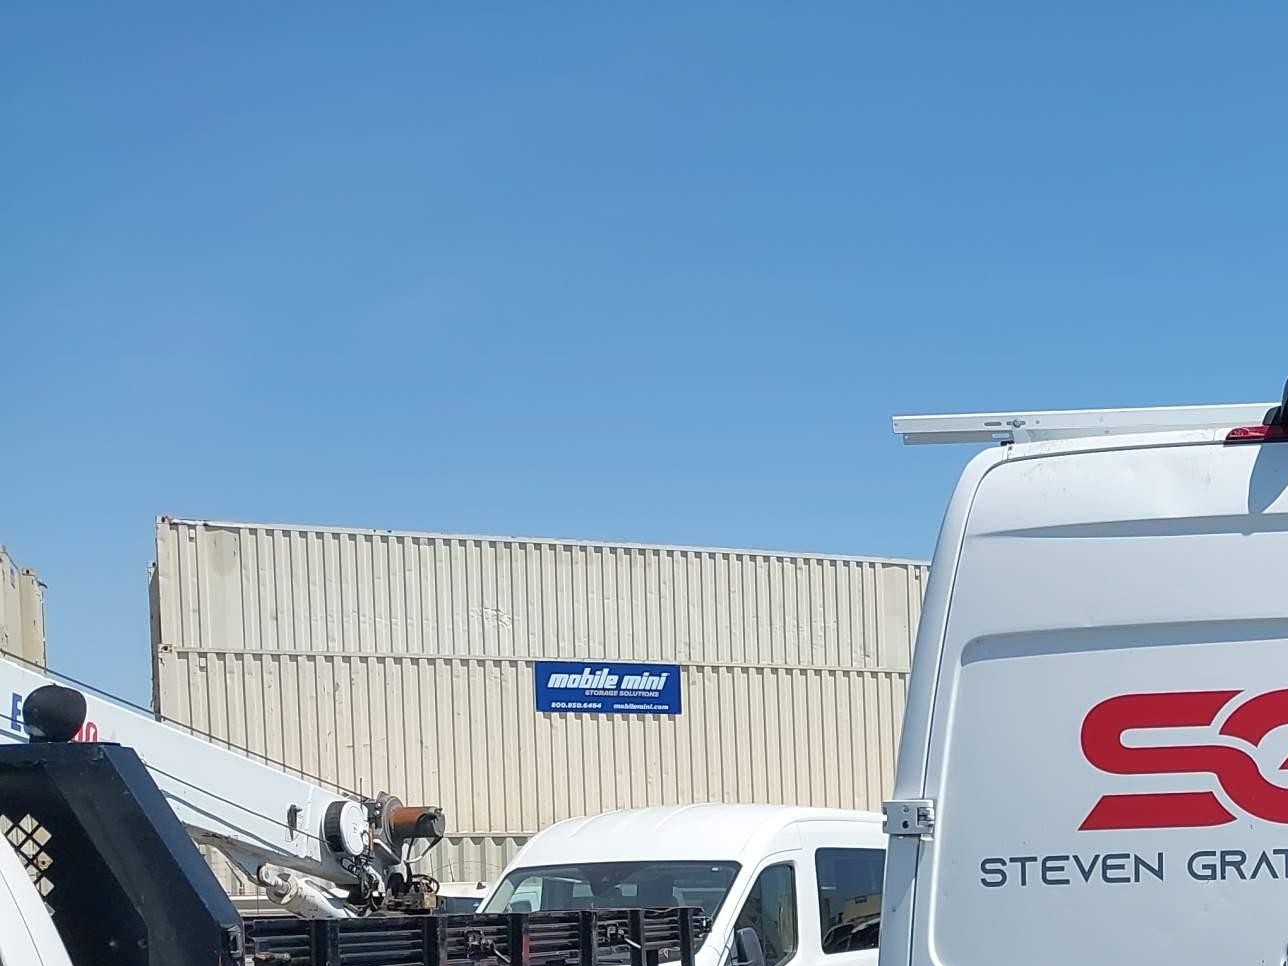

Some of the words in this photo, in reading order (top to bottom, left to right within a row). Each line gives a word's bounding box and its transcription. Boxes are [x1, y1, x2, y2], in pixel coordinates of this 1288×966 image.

[547, 667, 619, 689] mobile
[620, 671, 667, 691] mini
[980, 851, 1165, 888] STEVEN
